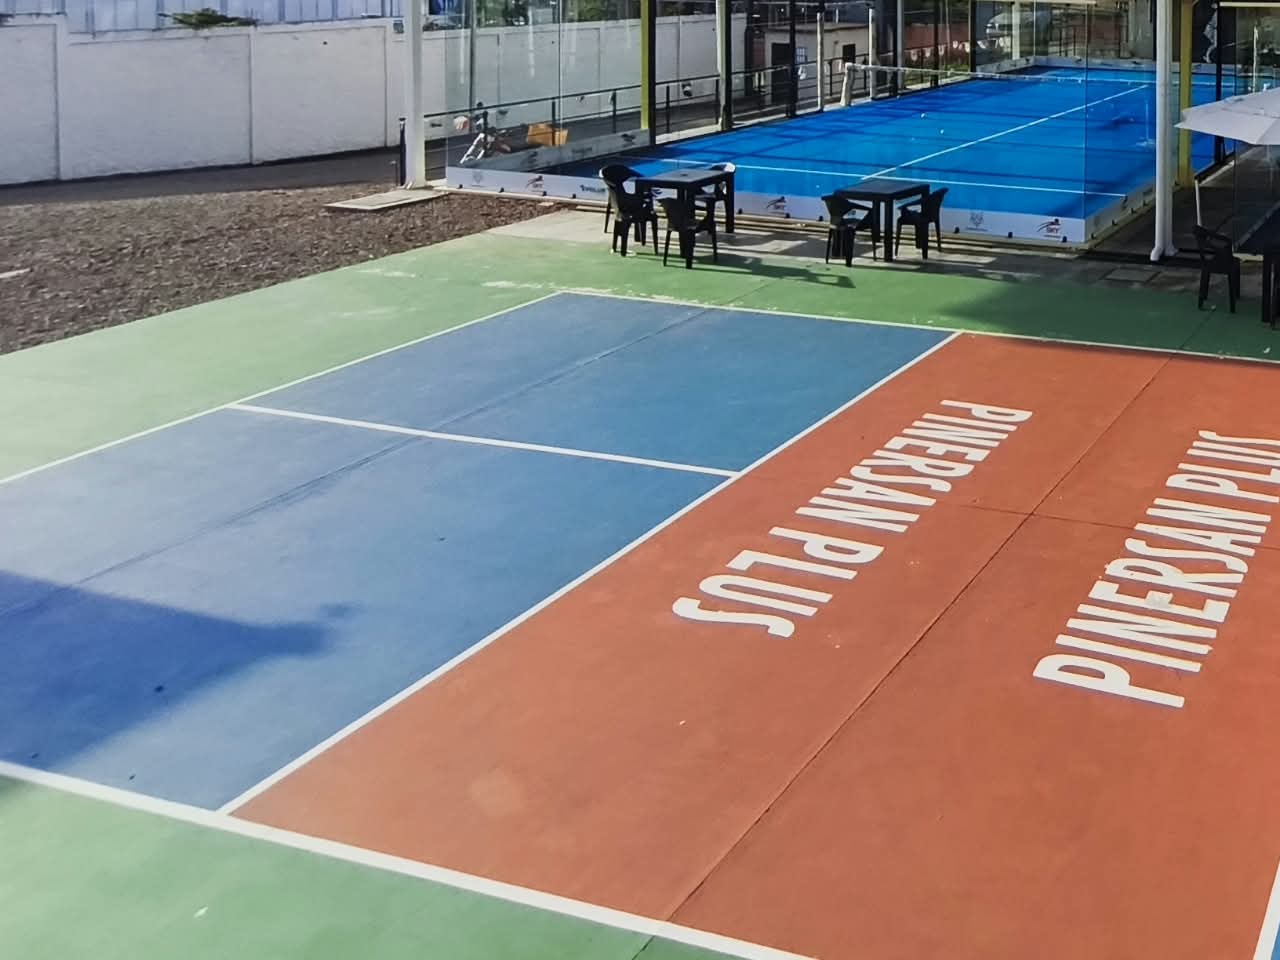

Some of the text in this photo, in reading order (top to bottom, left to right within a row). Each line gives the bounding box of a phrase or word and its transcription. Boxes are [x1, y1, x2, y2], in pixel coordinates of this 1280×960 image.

[672, 400, 1033, 638] PINERSAN PLUS
[1032, 497, 1272, 709] PINERSAN
